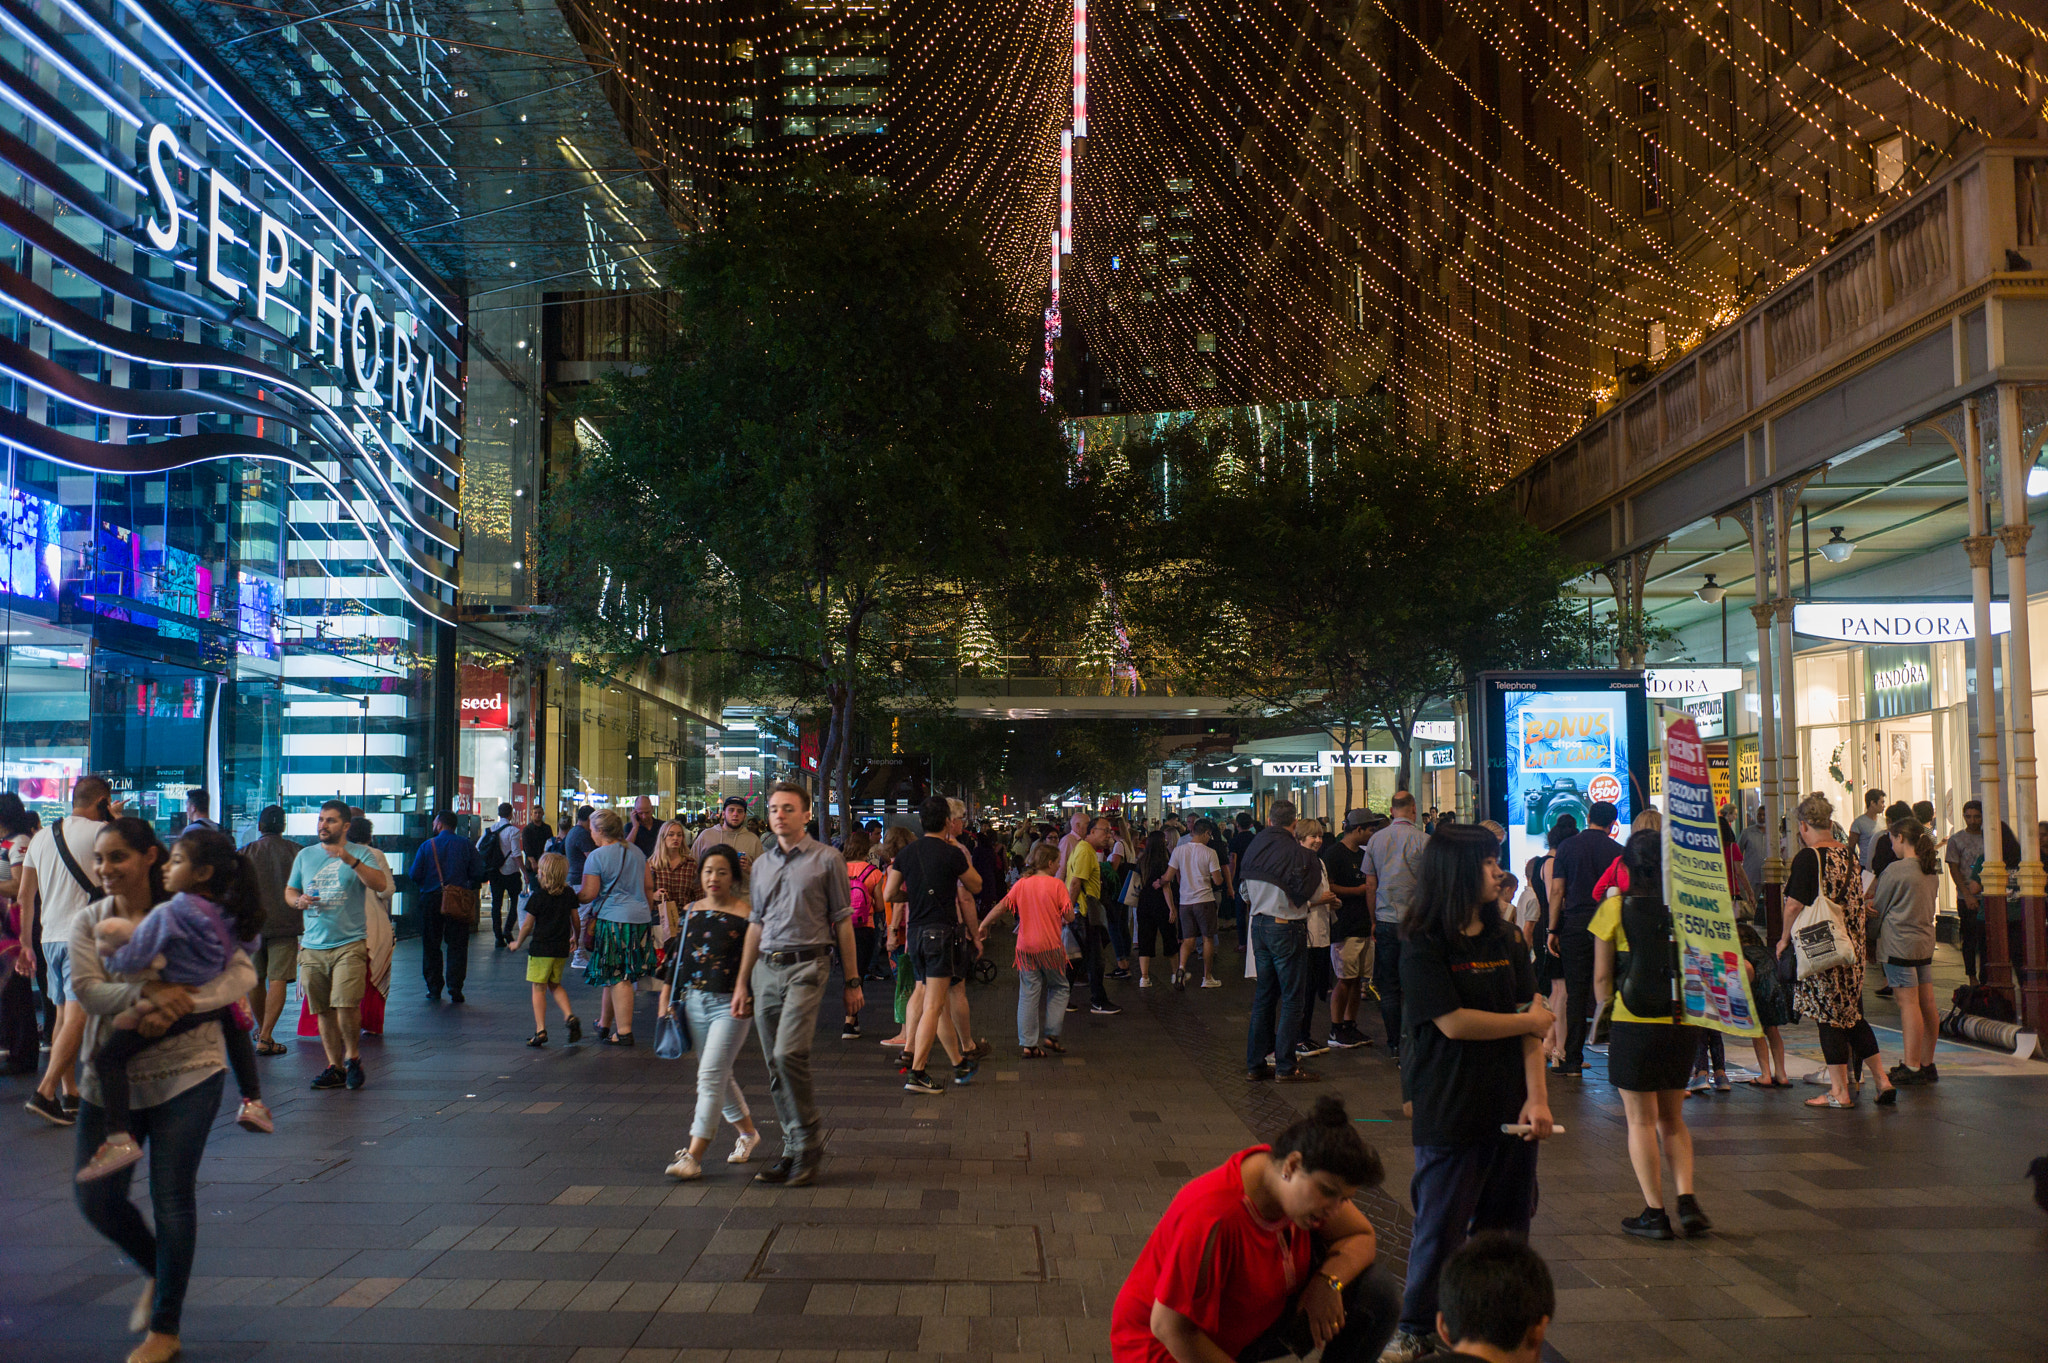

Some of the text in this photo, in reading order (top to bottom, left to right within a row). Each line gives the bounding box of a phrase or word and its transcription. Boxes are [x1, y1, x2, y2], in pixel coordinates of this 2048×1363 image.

[147, 122, 438, 445] SEPHORA
[1841, 617, 1970, 636] PANDORA
[1873, 663, 1925, 690] PANDORA
[1494, 681, 1537, 691] Telephone
[1645, 679, 1709, 693] NDORA
[461, 693, 502, 710] seed
[1525, 713, 1609, 745] BONUS
[1551, 739, 1583, 751] eftpos
[1330, 754, 1388, 764] MYER
[1525, 744, 1609, 768] GIFT CARD
[1272, 764, 1322, 774] MYER
[1740, 765, 1758, 784] SALE
[1212, 781, 1239, 789] HYPE
[1595, 779, 1613, 788] UP TO
[1591, 785, 1619, 799] $500
[1685, 831, 1720, 848] OPEN
[1692, 856, 1723, 872] SYDNEY
[1685, 914, 1716, 939] 55%
[1712, 920, 1731, 932] OFF
